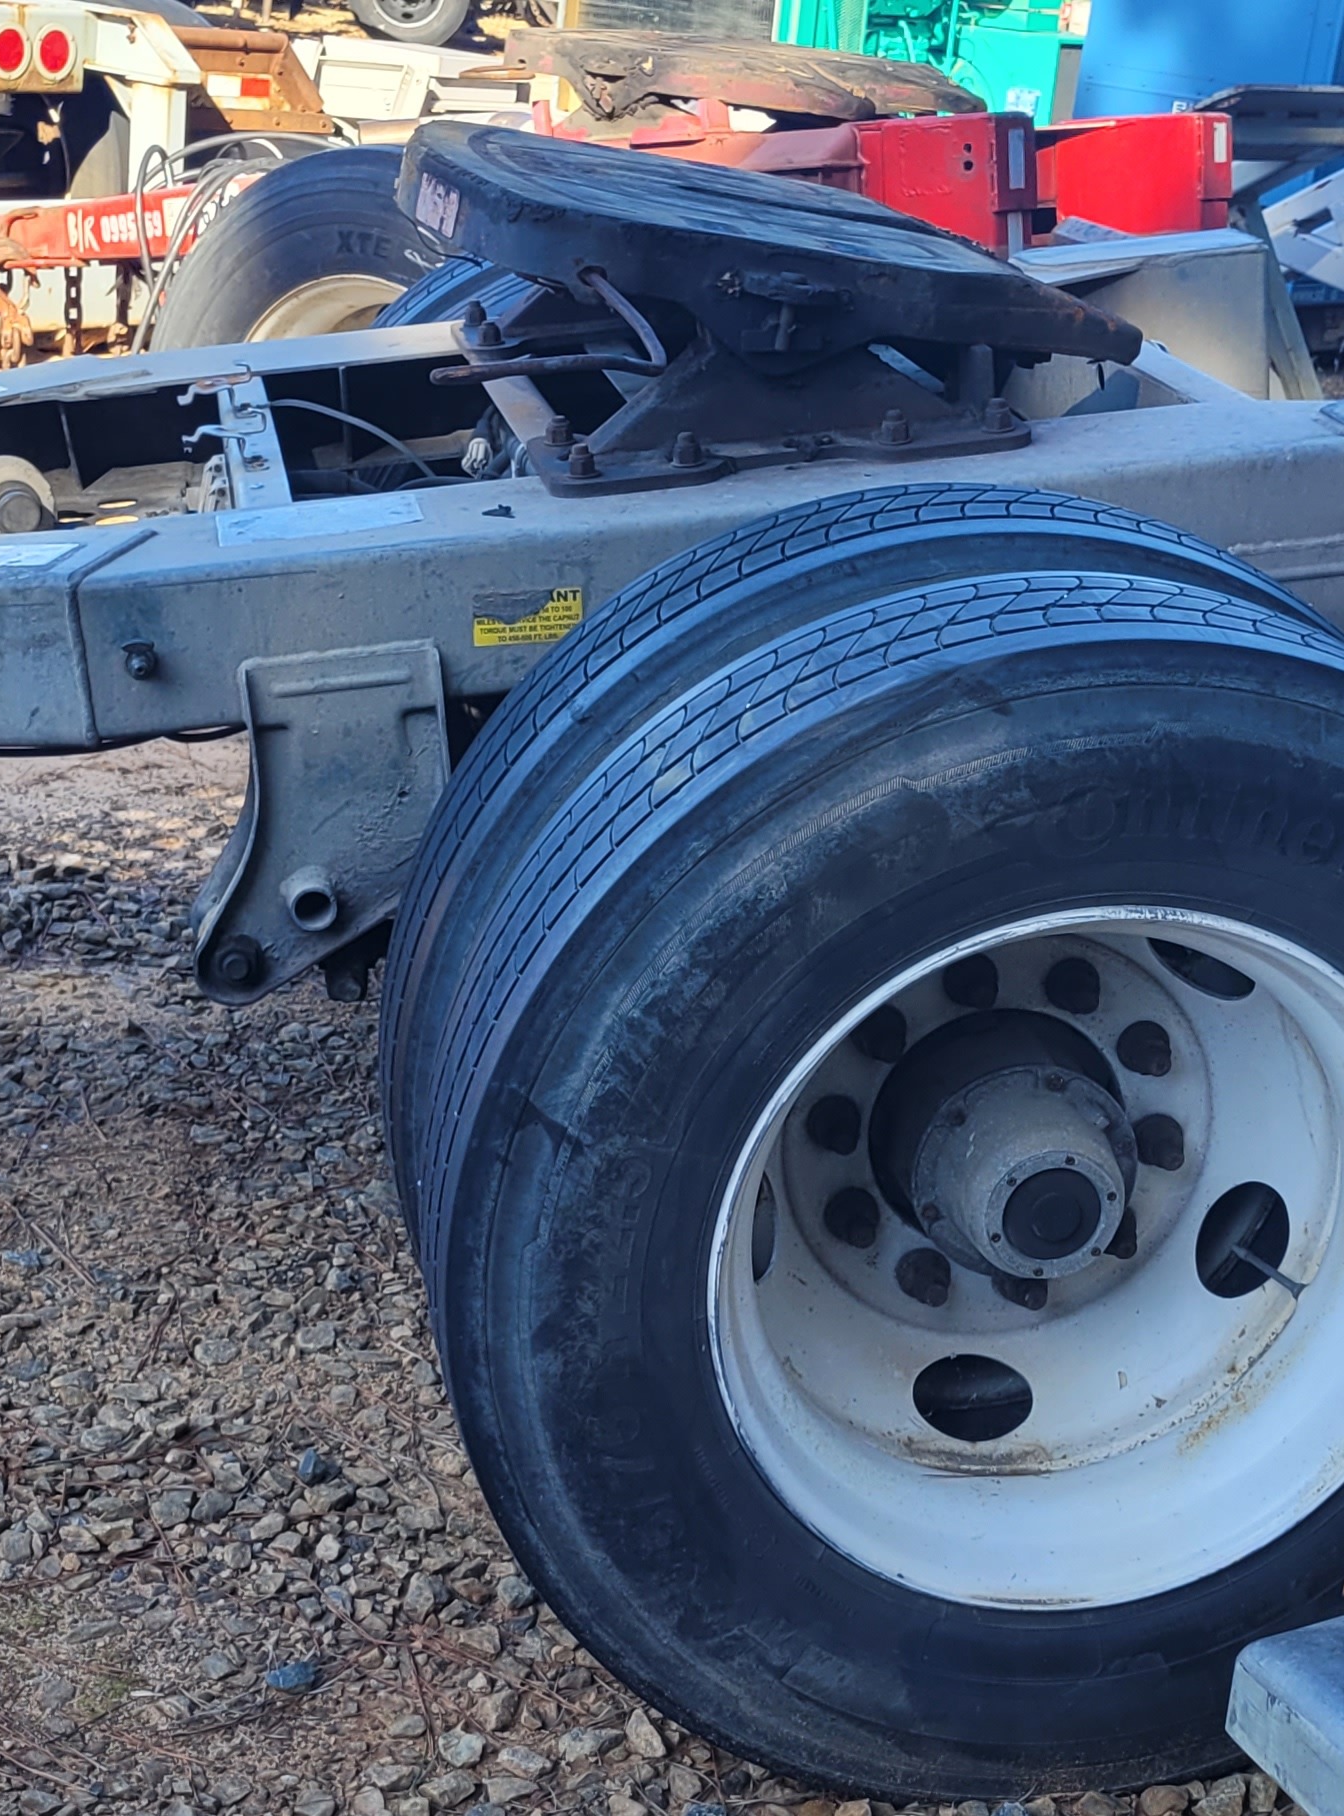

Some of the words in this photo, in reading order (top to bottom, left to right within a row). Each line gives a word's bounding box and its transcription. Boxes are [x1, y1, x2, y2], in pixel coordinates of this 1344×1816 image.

[479, 626, 508, 636] TORQUE
[508, 625, 528, 634] MUST
[529, 624, 538, 633] BE
